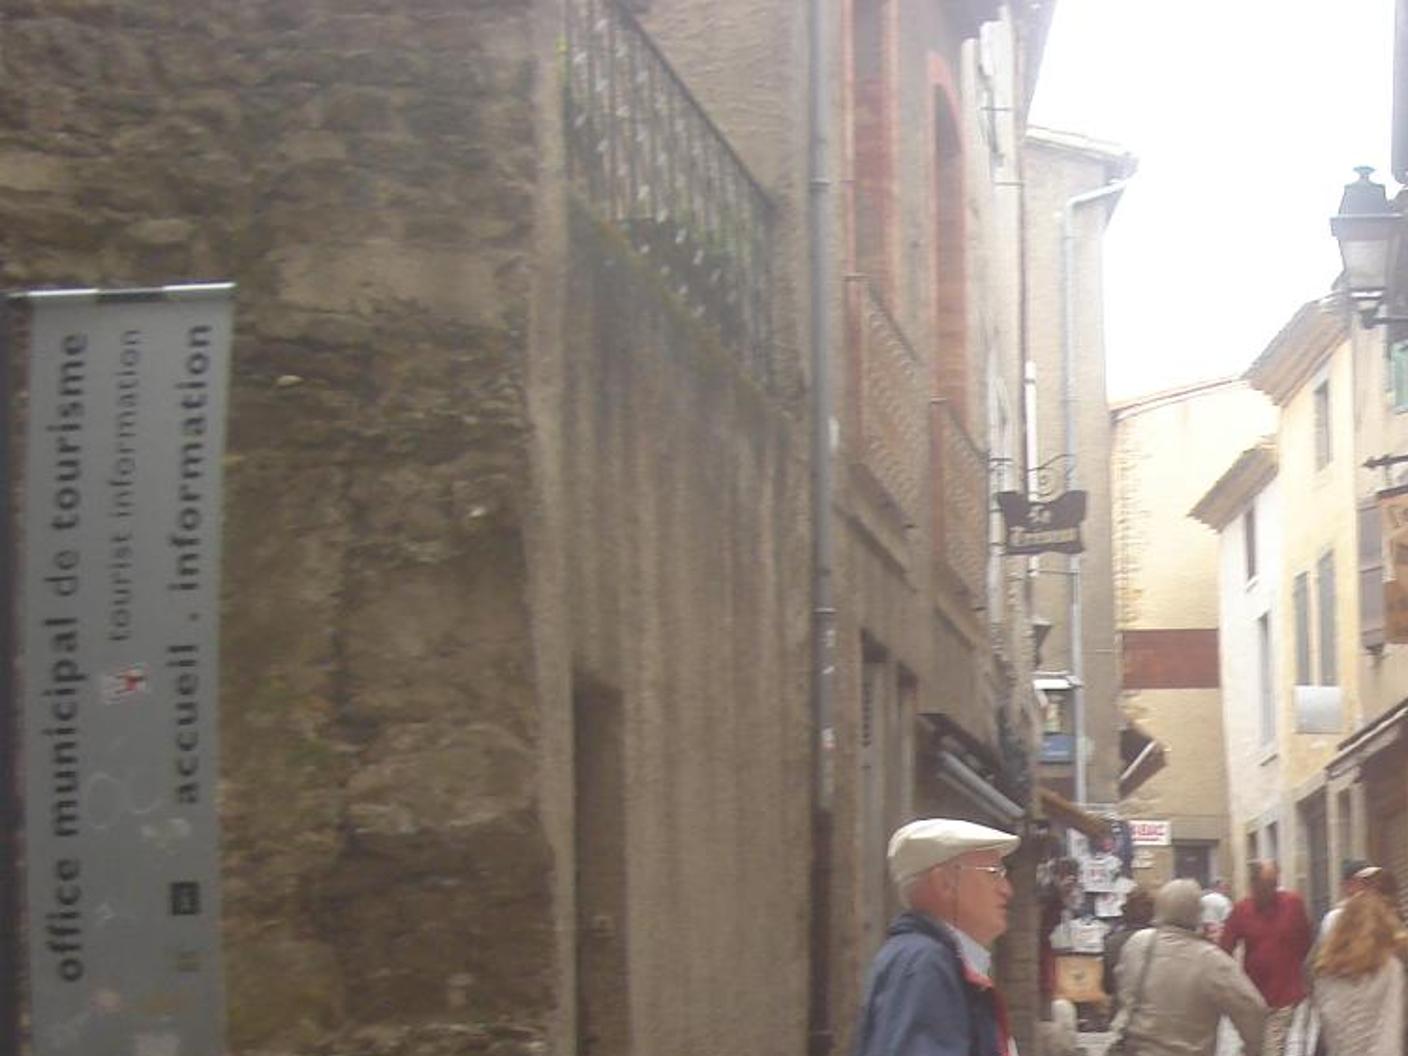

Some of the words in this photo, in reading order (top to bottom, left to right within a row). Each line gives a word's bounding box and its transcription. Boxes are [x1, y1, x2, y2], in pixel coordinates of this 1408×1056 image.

[45, 331, 89, 531] tourisme
[104, 328, 143, 519] information
[166, 324, 214, 592] information
[42, 549, 82, 597] de
[106, 533, 136, 642] tourist
[38, 615, 89, 838] municipal
[166, 644, 200, 805] accueil
[45, 857, 85, 983] office
